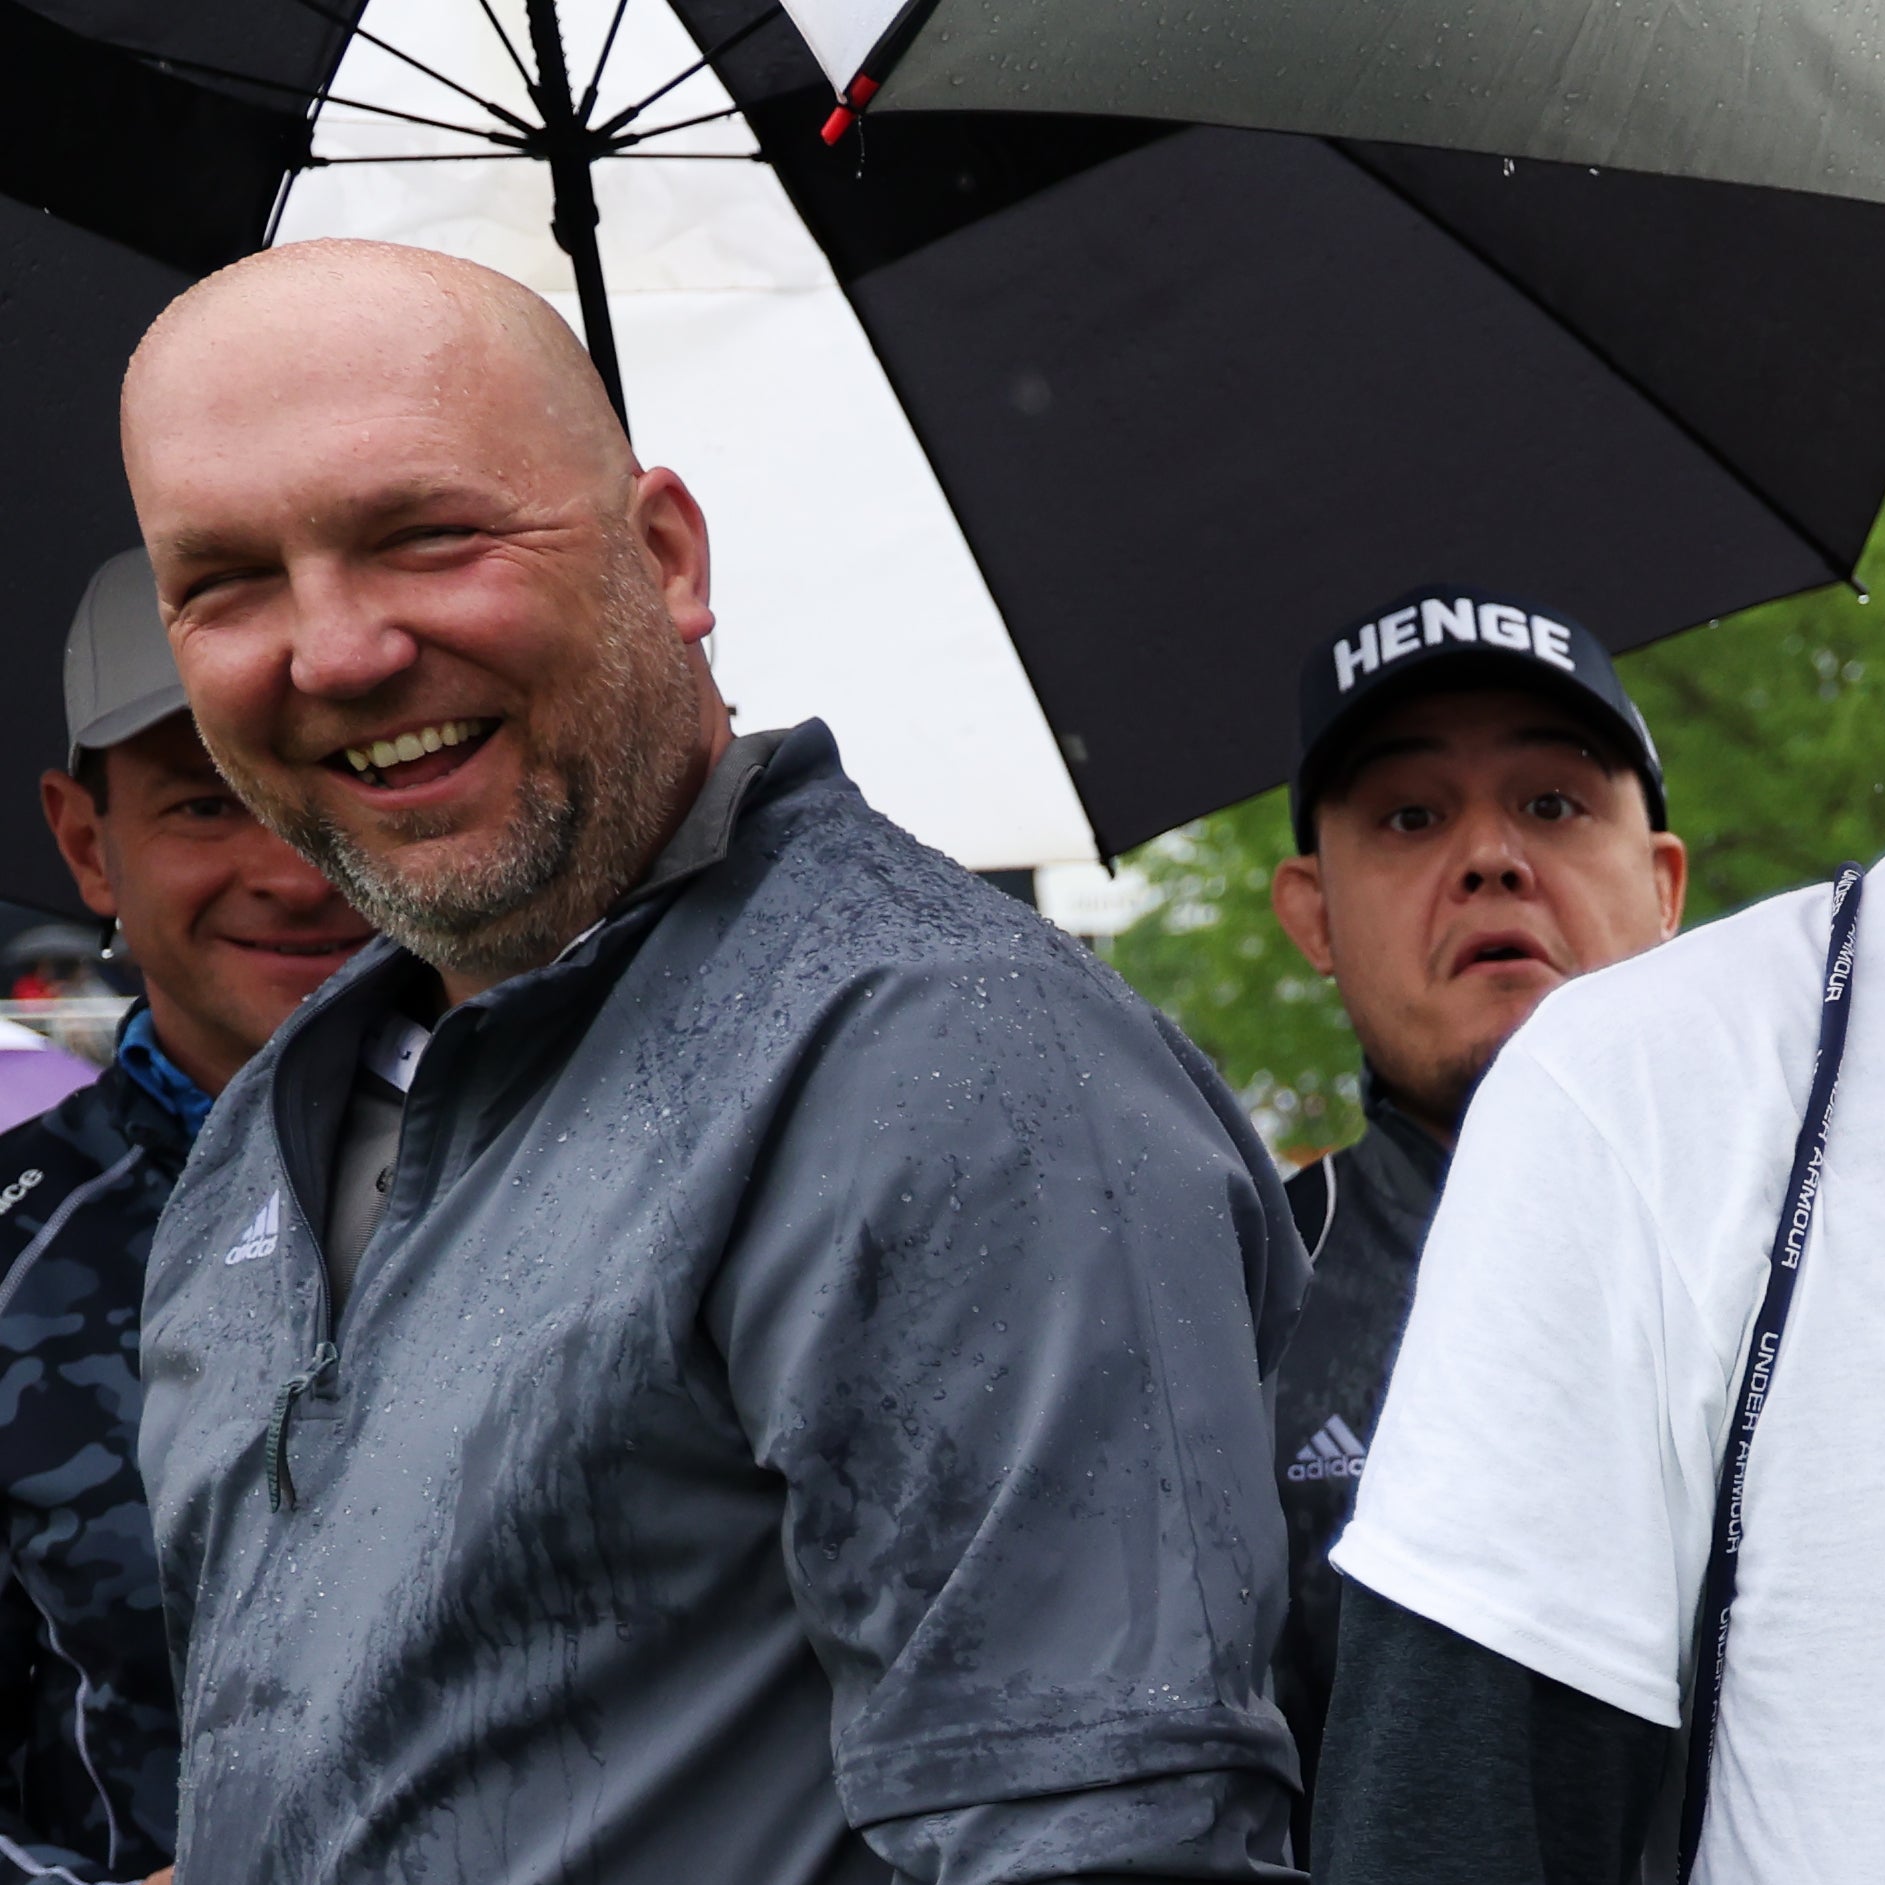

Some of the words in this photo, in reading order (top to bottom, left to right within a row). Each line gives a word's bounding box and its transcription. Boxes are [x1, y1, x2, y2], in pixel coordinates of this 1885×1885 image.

[1333, 597, 1575, 693] HENGE
[1781, 1146, 1824, 1270] ARMOUR
[1742, 1331, 1779, 1431] UNDER
